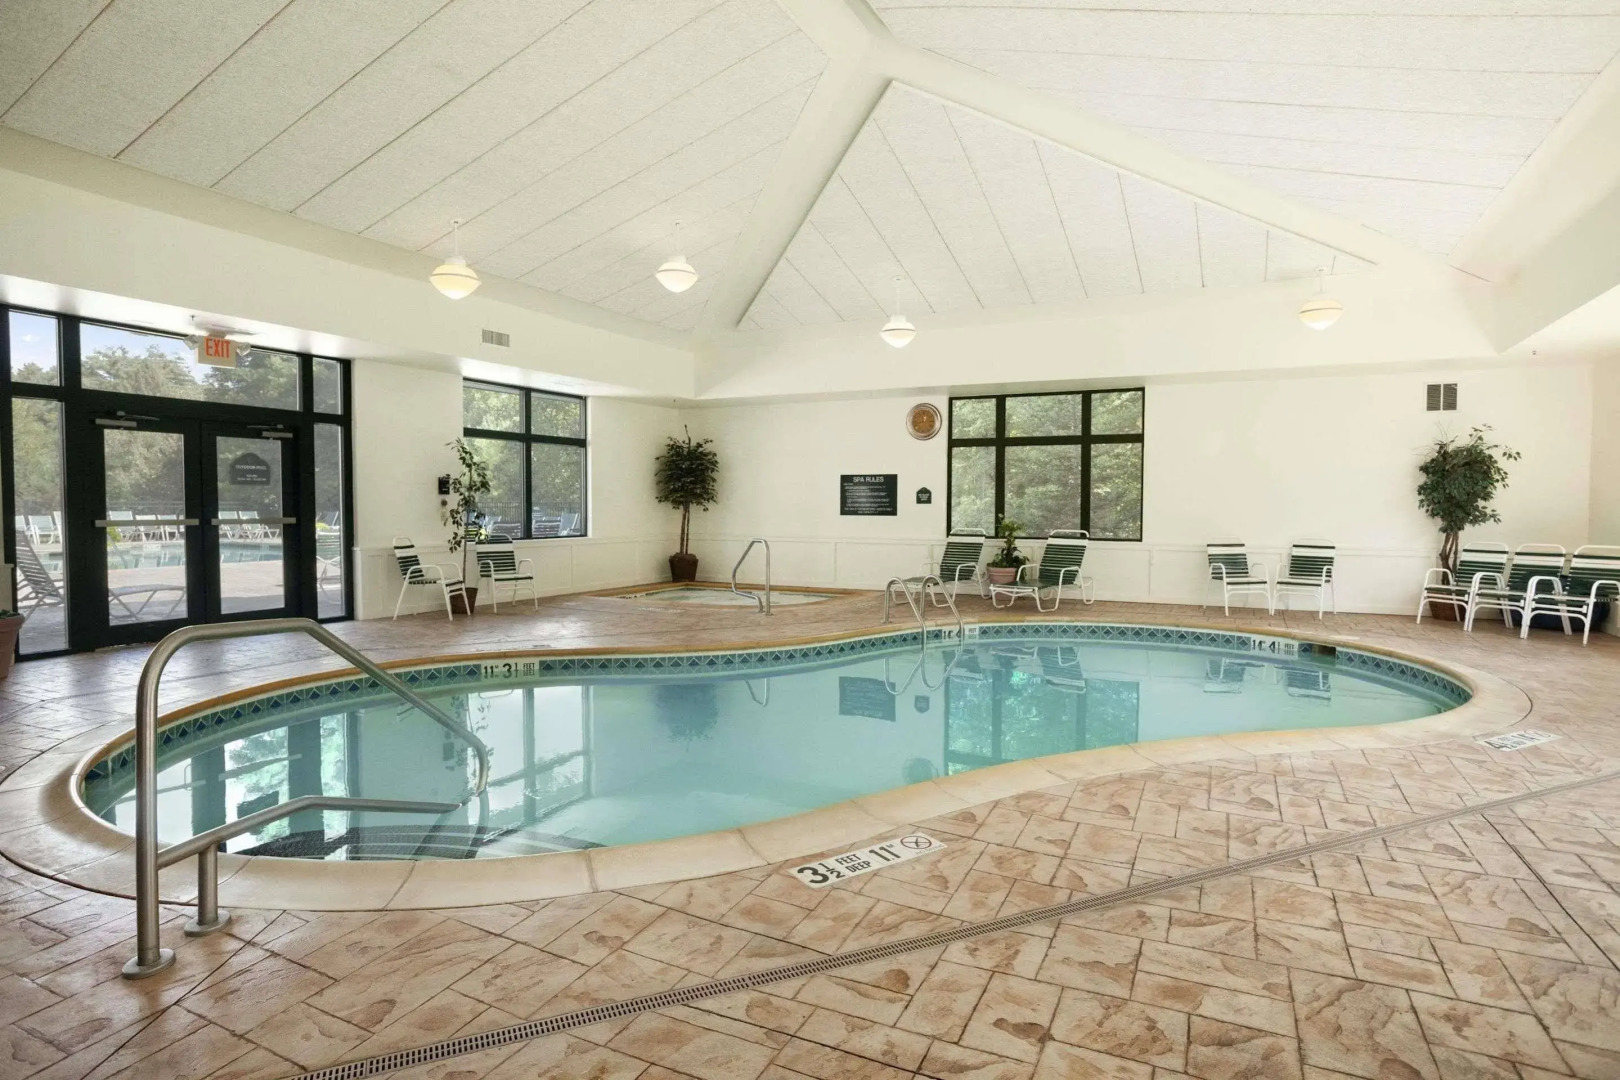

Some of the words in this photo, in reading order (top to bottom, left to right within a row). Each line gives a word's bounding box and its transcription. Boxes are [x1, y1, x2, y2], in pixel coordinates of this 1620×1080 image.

[206, 337, 231, 359] EXIT
[835, 853, 862, 866] FEET
[845, 860, 872, 874] DEEP
